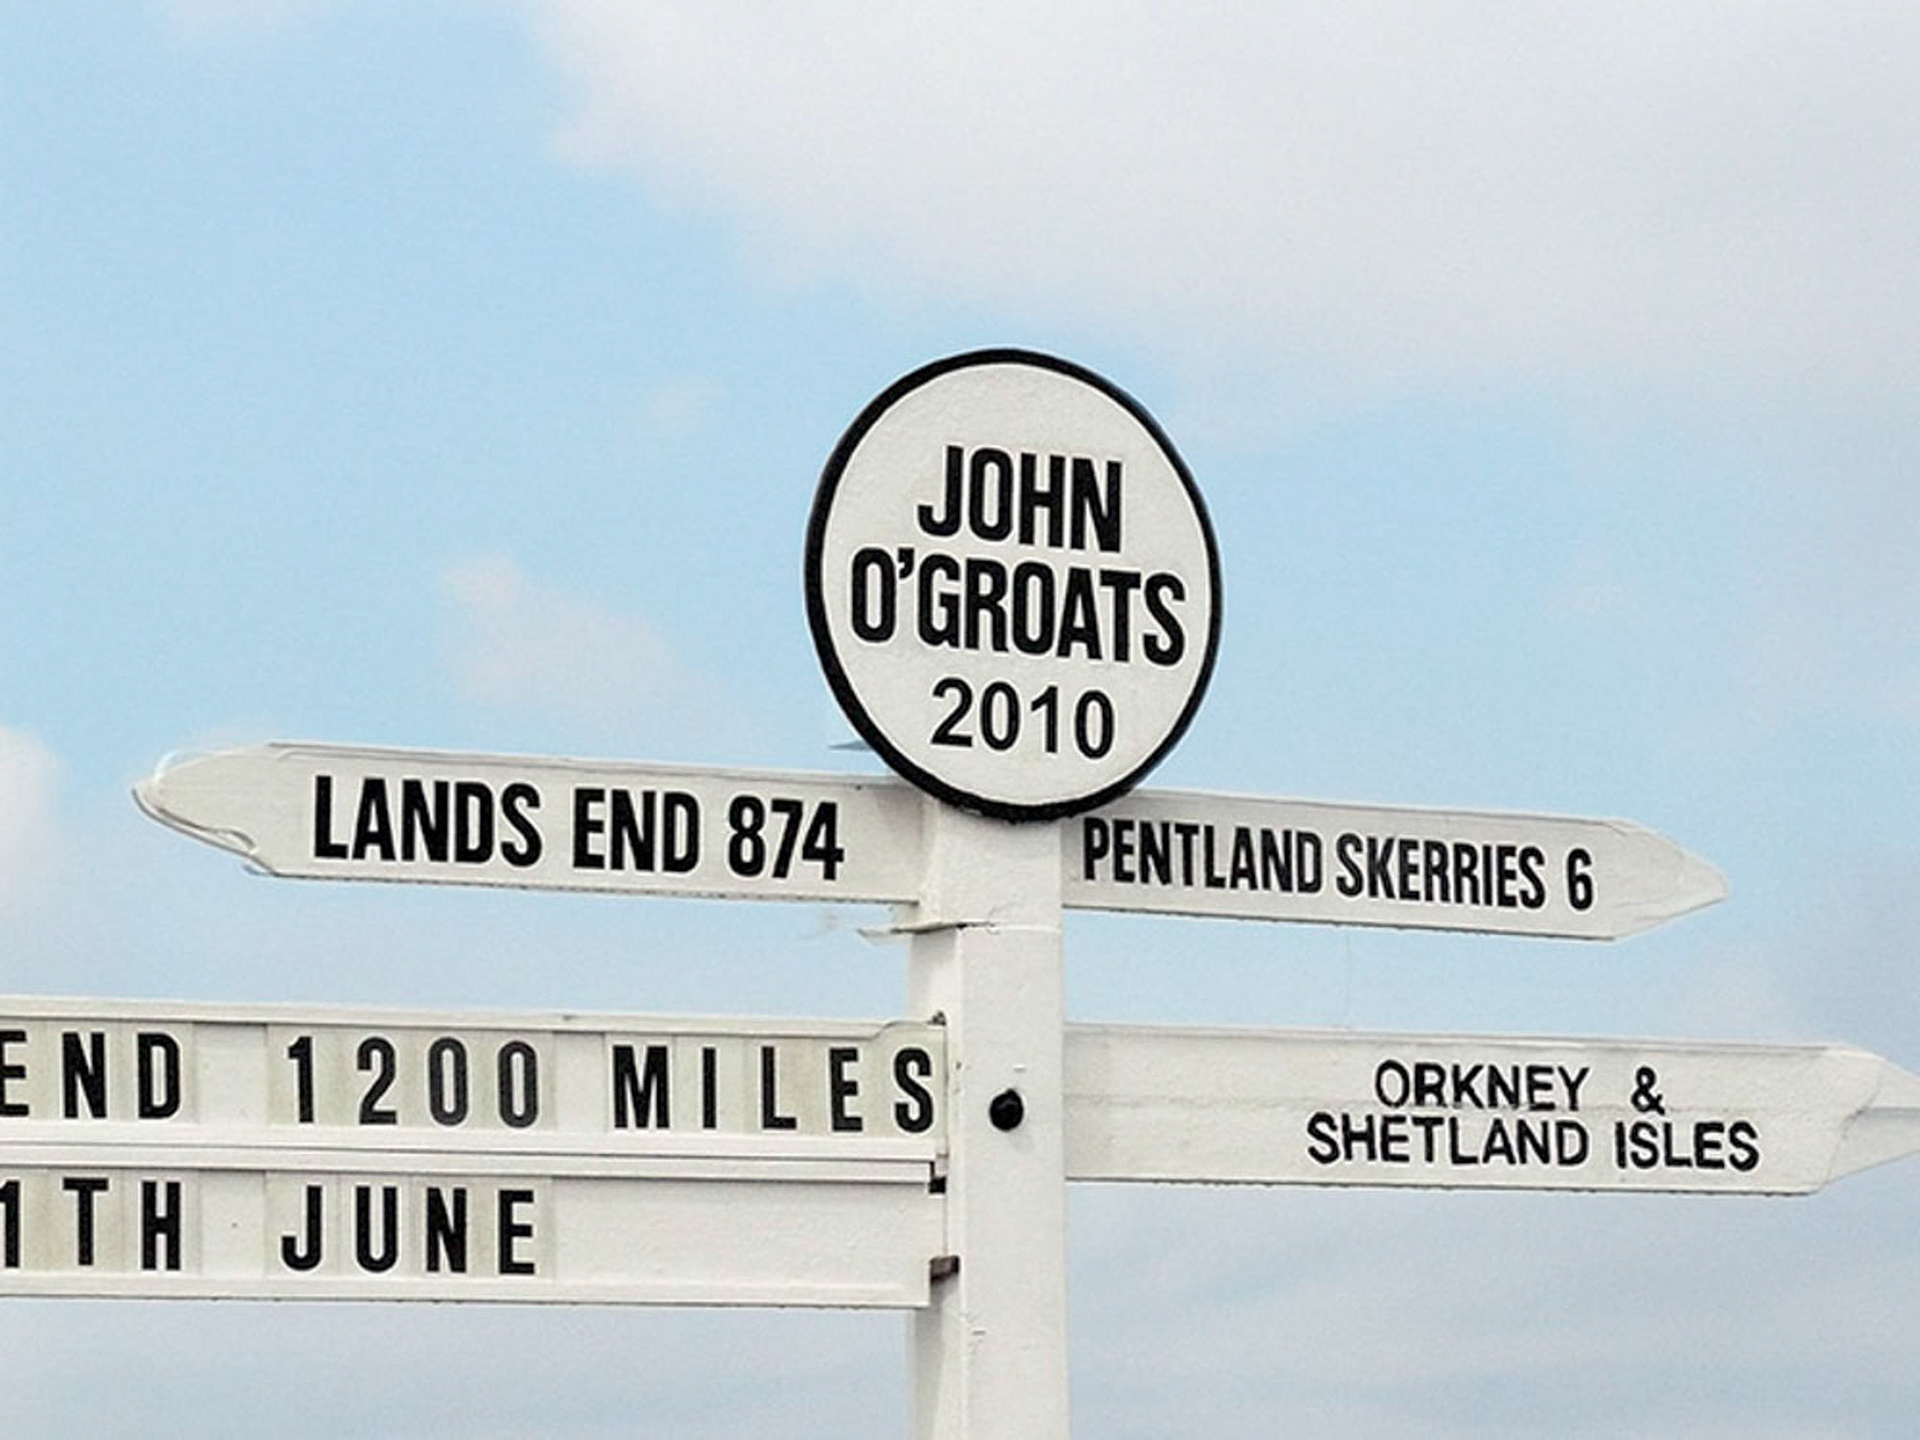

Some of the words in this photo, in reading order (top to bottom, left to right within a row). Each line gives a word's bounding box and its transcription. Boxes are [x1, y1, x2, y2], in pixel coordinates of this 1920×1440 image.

[918, 446, 1121, 554] JOHN
[931, 678, 1114, 759] 2010
[314, 775, 541, 868] LANDS
[572, 787, 700, 873] END
[728, 795, 845, 881] 874
[1082, 815, 1322, 894] PENTLAND
[1336, 833, 1546, 909] SKERRIES
[1567, 848, 1593, 911] 6
[0, 1029, 181, 1120] END
[288, 1036, 539, 1129] 1200
[612, 1044, 934, 1134] MILES
[1375, 1059, 1589, 1112] ORKNEY
[1631, 1066, 1666, 1116] &
[1307, 1111, 1589, 1166] SHETLAND
[1615, 1121, 1760, 1172] ISLES
[0, 1176, 181, 1271] 1TH
[281, 1184, 536, 1275] JUNE
